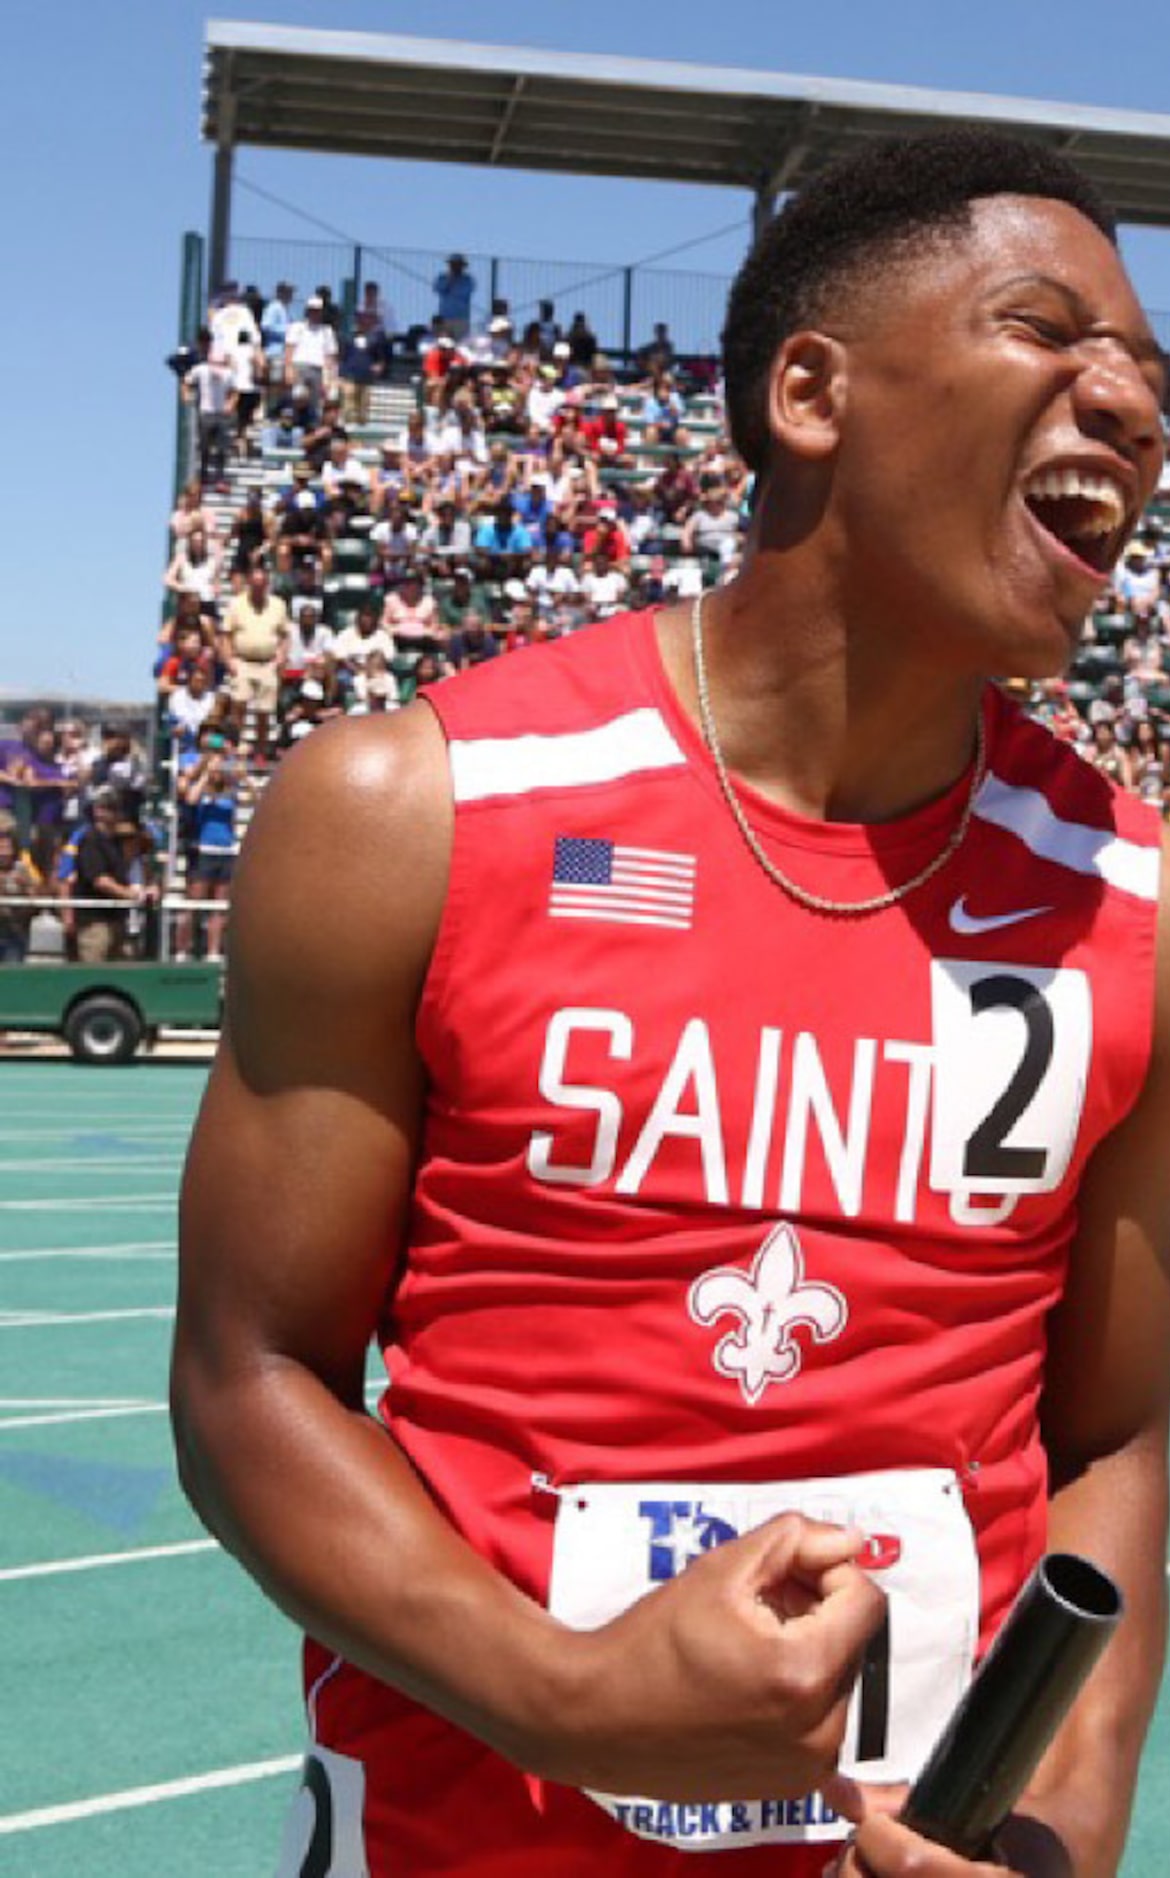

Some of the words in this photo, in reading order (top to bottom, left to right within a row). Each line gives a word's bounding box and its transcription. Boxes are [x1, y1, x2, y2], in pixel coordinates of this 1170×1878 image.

[526, 1007, 1018, 1226] SAINT
[962, 973, 1055, 1179] 2
[615, 1803, 721, 1838] TRACK
[730, 1801, 753, 1833] &
